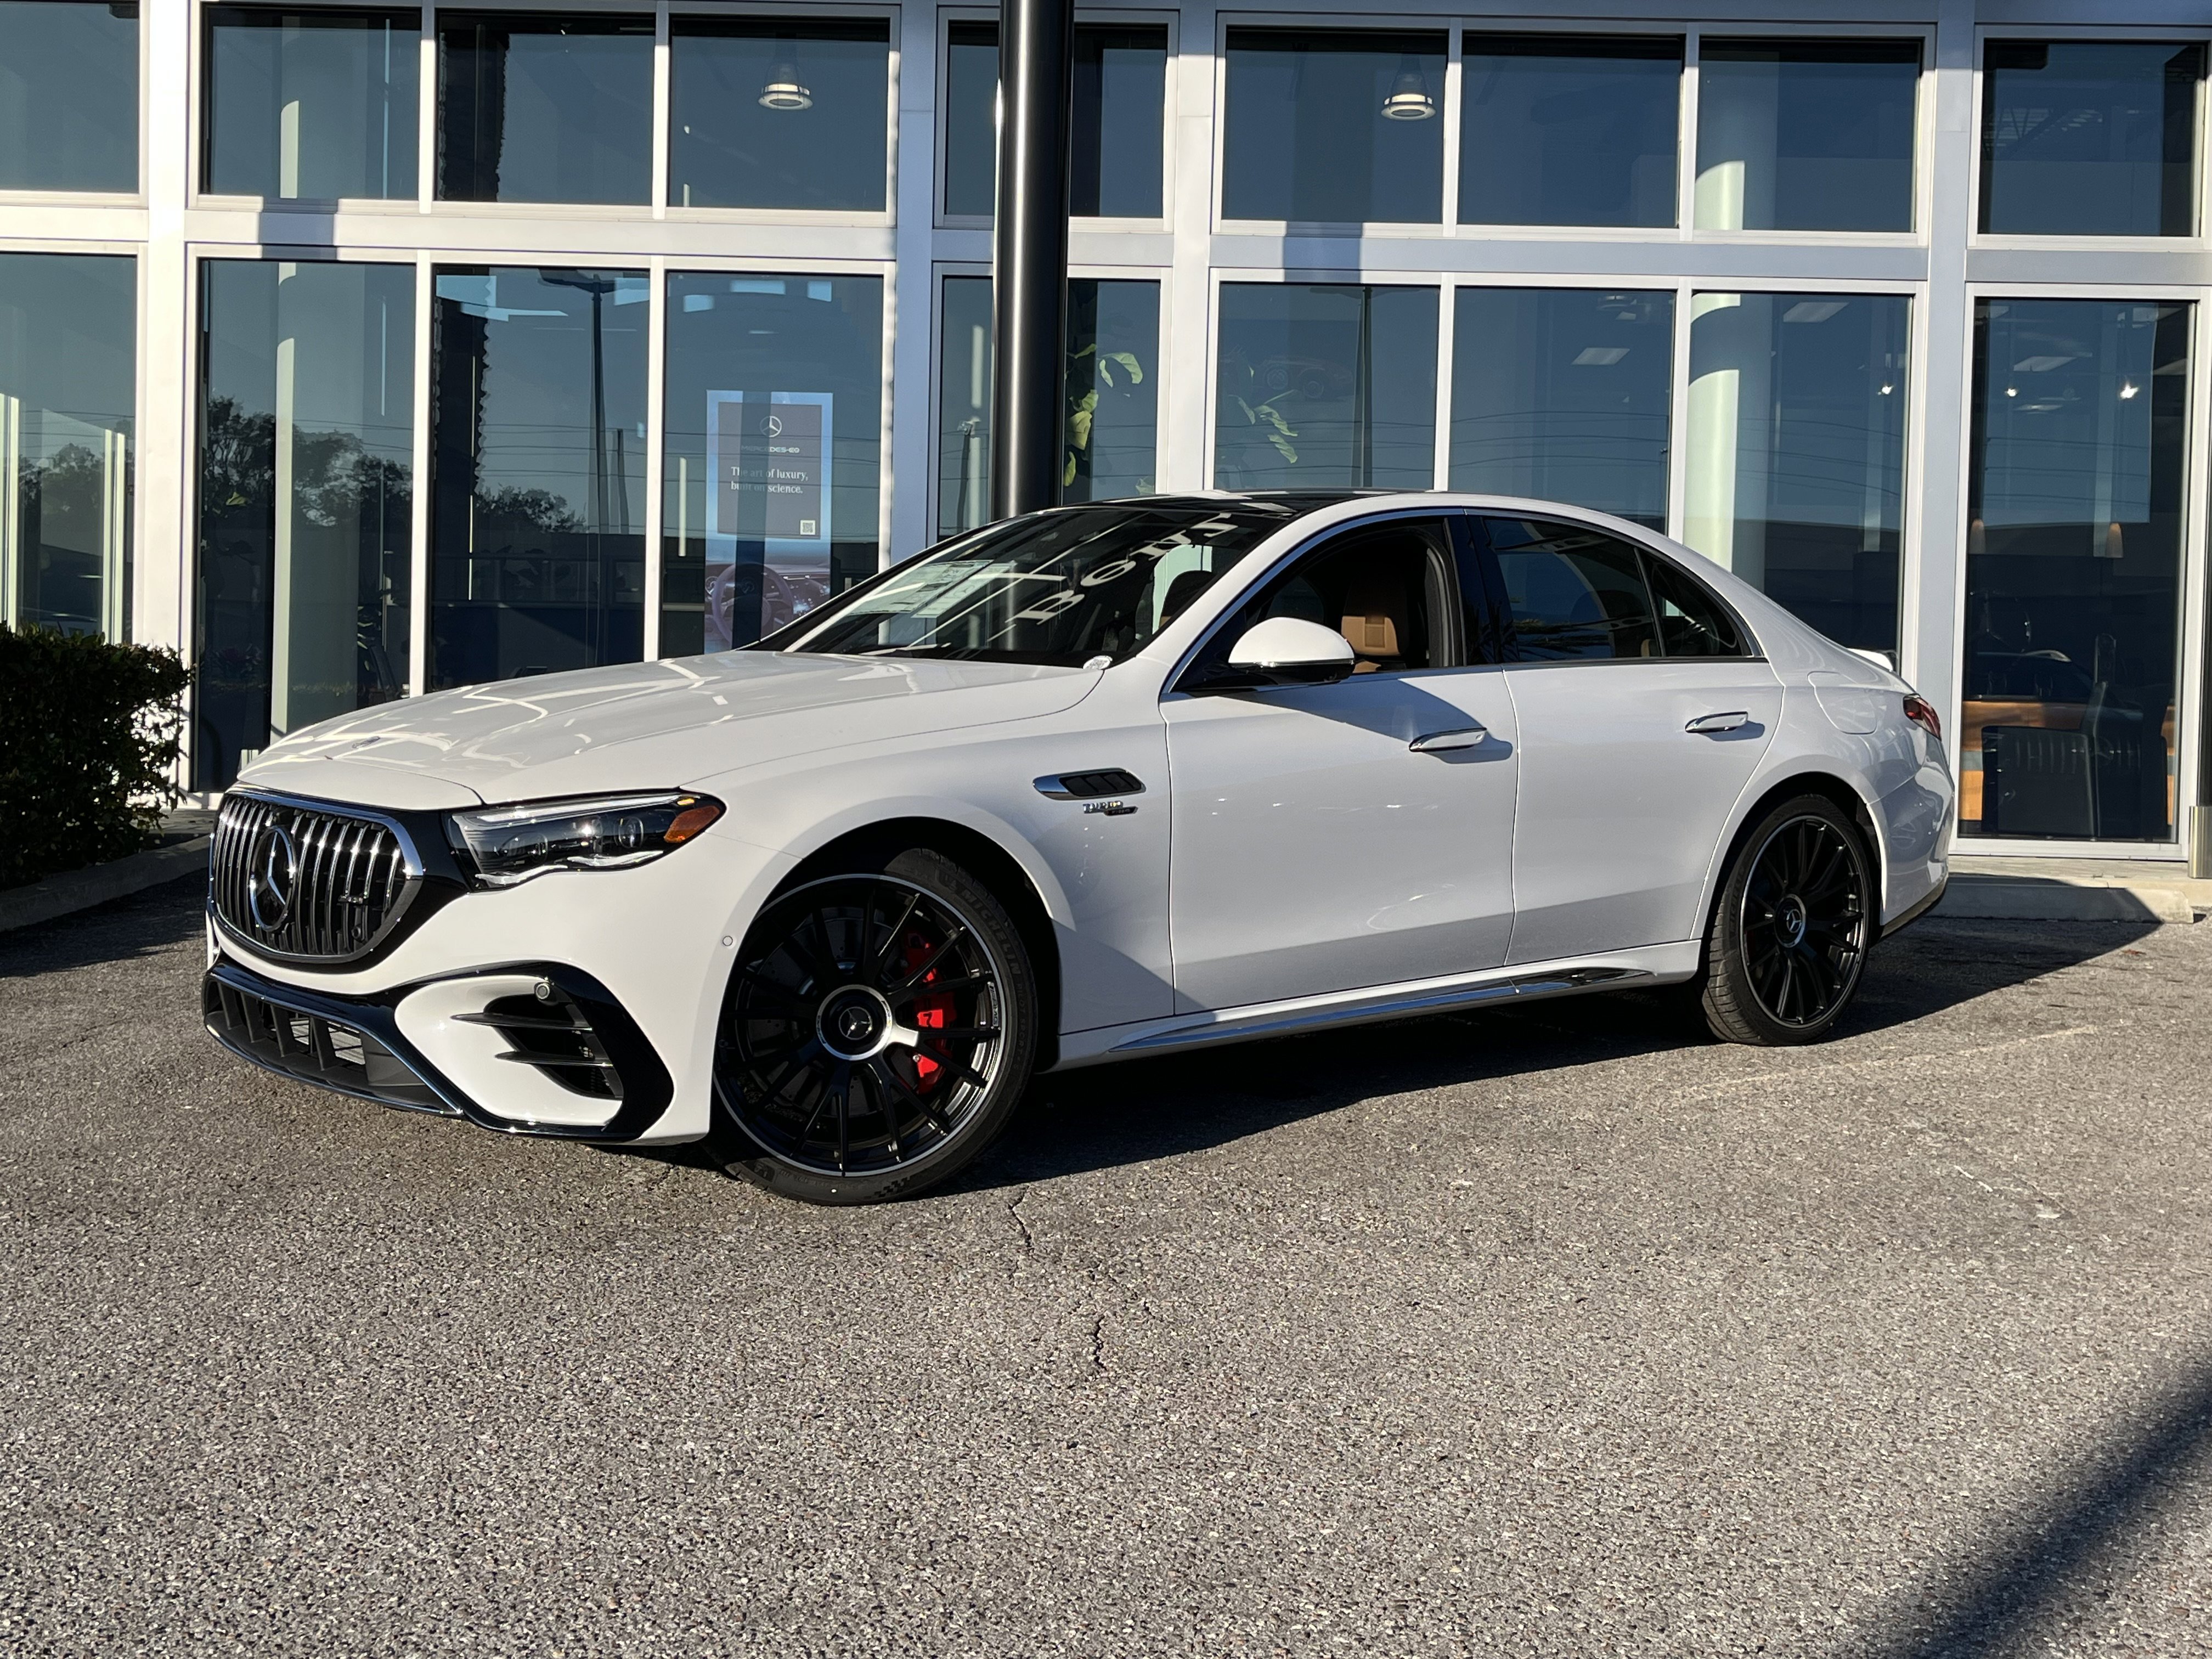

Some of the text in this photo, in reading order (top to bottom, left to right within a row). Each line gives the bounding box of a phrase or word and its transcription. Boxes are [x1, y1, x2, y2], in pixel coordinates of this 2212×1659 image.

[731, 466, 809, 482] The art of luxury,
[731, 481, 752, 490] built
[768, 483, 803, 494] science.
[960, 888, 1022, 975] MICHELIN
